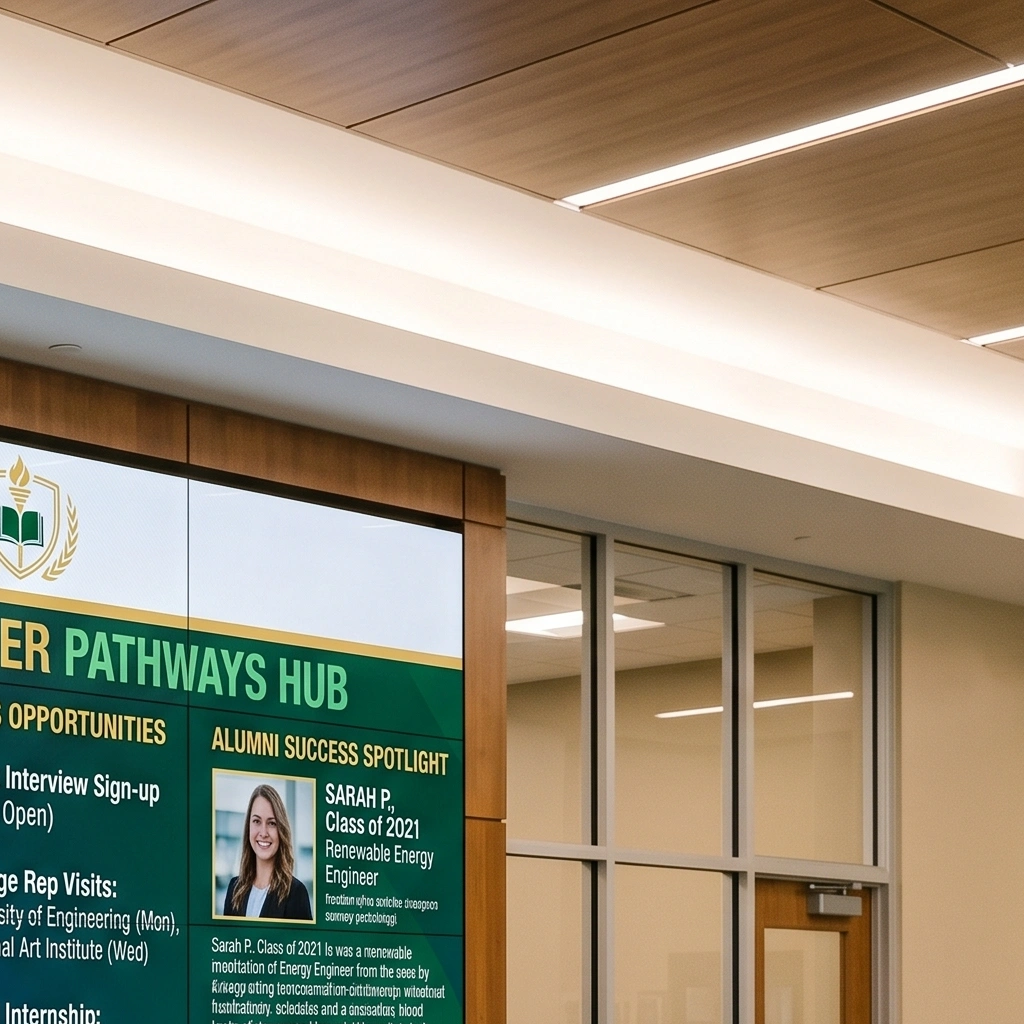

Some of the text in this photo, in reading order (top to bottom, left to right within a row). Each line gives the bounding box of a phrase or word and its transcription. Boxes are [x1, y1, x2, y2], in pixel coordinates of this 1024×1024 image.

[65, 628, 267, 701] PATHWAYS
[279, 657, 348, 711] HUB
[8, 703, 167, 746] OPPORTUNITIES
[211, 726, 449, 776] ALUMNI SUCCESS SPOTLIGHT
[5, 765, 88, 796] Interview
[93, 774, 160, 807] Sign-up
[325, 783, 376, 809] SARAH
[3, 800, 54, 833] Open)
[325, 810, 419, 840] Class of 2021
[325, 839, 434, 870] Renewable Energy
[24, 870, 58, 900] Rep
[63, 872, 117, 899] Visits:
[325, 865, 378, 888] Engineer
[28, 904, 43, 927] of
[47, 906, 131, 936] Engineering
[135, 909, 180, 936] (Mon),
[19, 938, 41, 960] Art
[46, 937, 103, 961] Institute
[107, 940, 149, 967] (Wed)
[211, 936, 242, 953] Sarah
[257, 938, 284, 955] Class
[286, 940, 297, 956] of
[298, 940, 322, 957] 2021
[335, 946, 353, 958] was
[356, 946, 362, 958] a
[267, 960, 278, 975] of
[279, 961, 312, 980] Energy
[314, 962, 354, 980] Engineer
[356, 963, 377, 978] from
[380, 964, 394, 979] the
[418, 964, 430, 982] by
[321, 1002, 338, 1016] and
[341, 1004, 347, 1016] a
